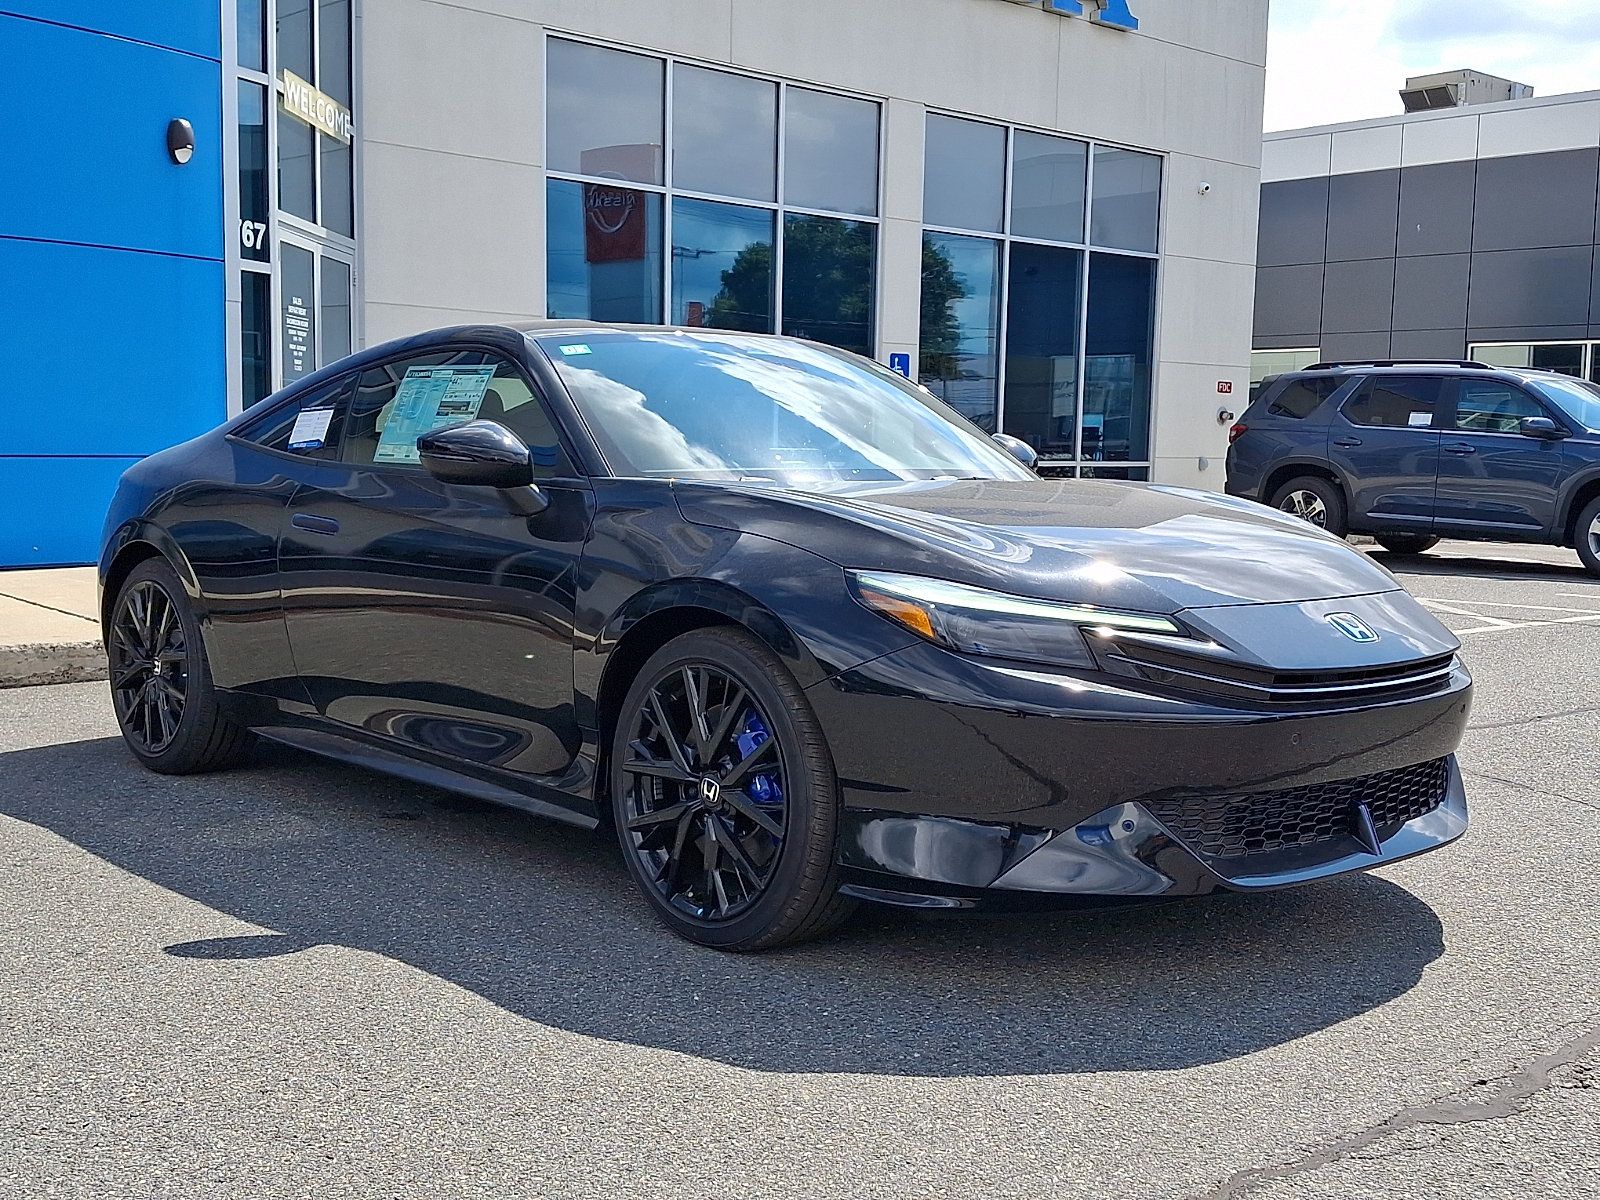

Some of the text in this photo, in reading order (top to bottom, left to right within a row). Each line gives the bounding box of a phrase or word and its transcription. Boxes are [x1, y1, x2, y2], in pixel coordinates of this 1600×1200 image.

[285, 77, 351, 137] WELCOME
[239, 219, 266, 250] 67
[1218, 383, 1231, 392] FDC
